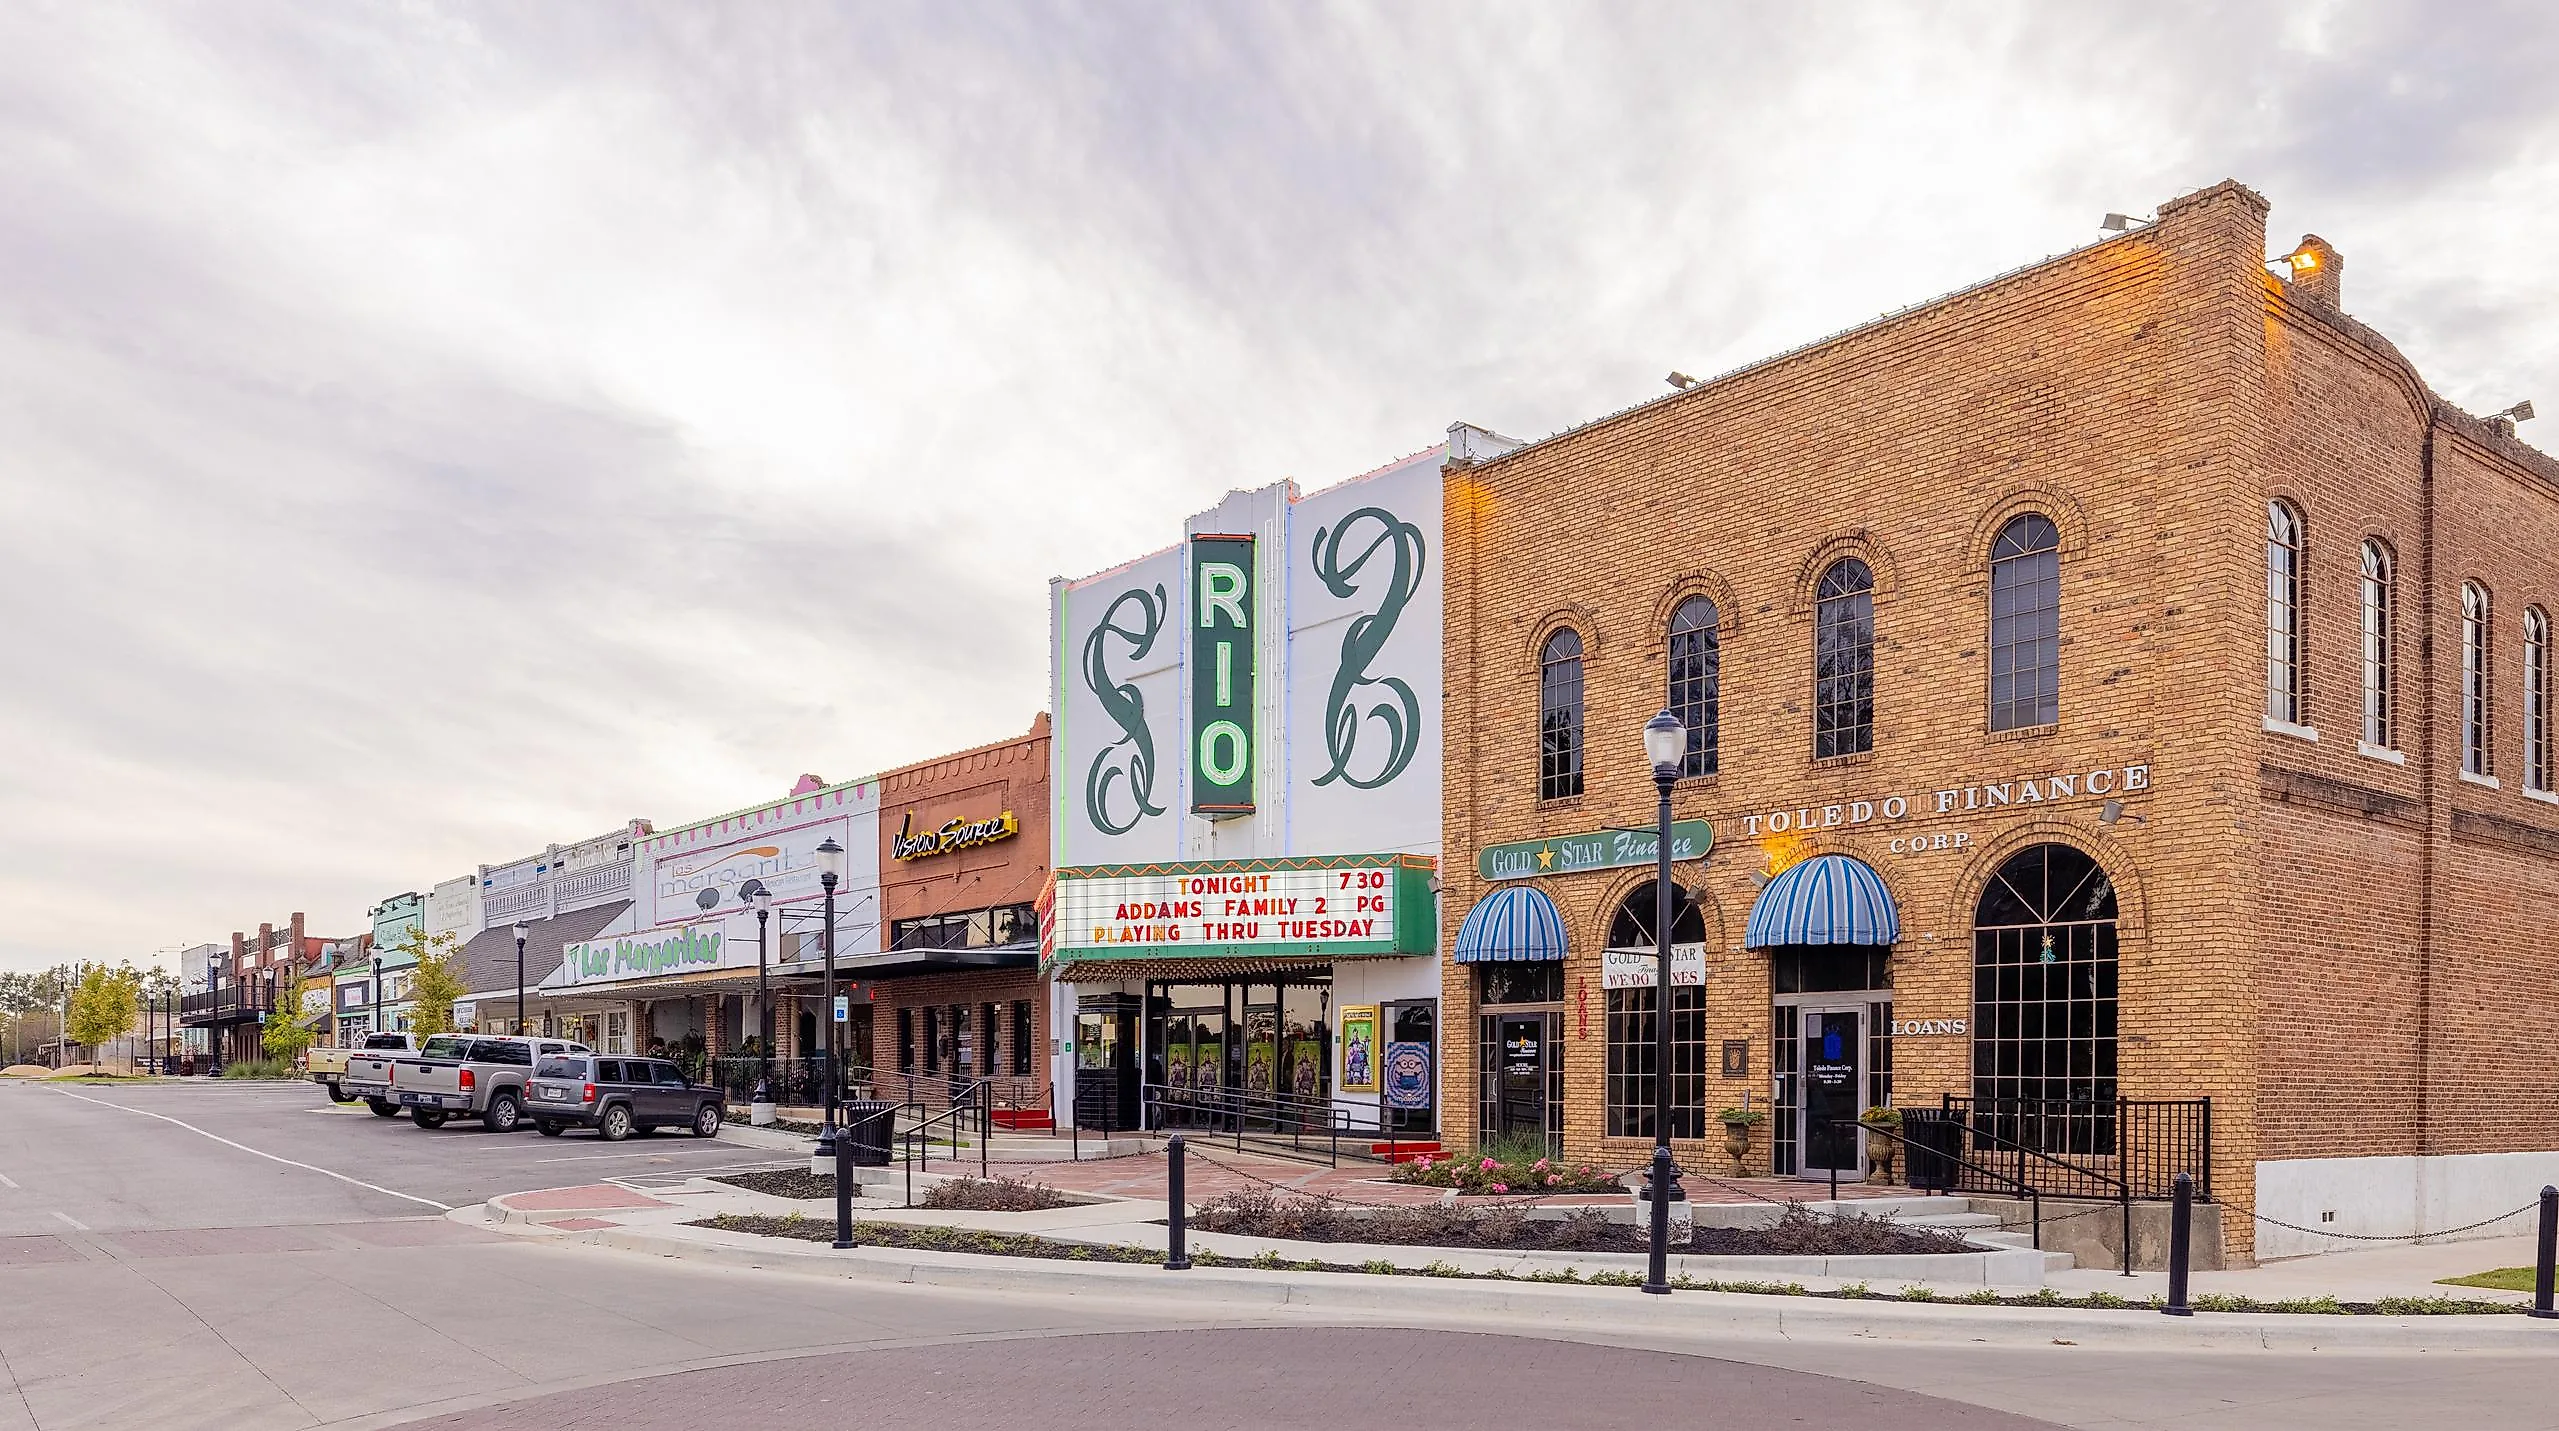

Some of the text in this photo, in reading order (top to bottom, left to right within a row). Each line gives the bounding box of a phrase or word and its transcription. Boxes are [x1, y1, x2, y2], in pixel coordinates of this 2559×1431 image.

[1200, 562, 1247, 786] RIO
[1743, 764, 2149, 836] TOLEDO FINANCE
[1614, 832, 1692, 861] Finace
[1890, 832, 1976, 853] CORP.
[1178, 875, 1271, 895] TONIGHT
[1116, 895, 1384, 920] ADDAMS FAMILY 2 PG
[1094, 919, 1374, 943] PLAYING THRU TUESDAY
[581, 927, 721, 978] Las Margaritas
[1632, 973, 1649, 986] DO
[1672, 970, 1698, 984] XES
[1578, 976, 1588, 1039] LOANS
[1891, 1019, 1966, 1036] LOANS
